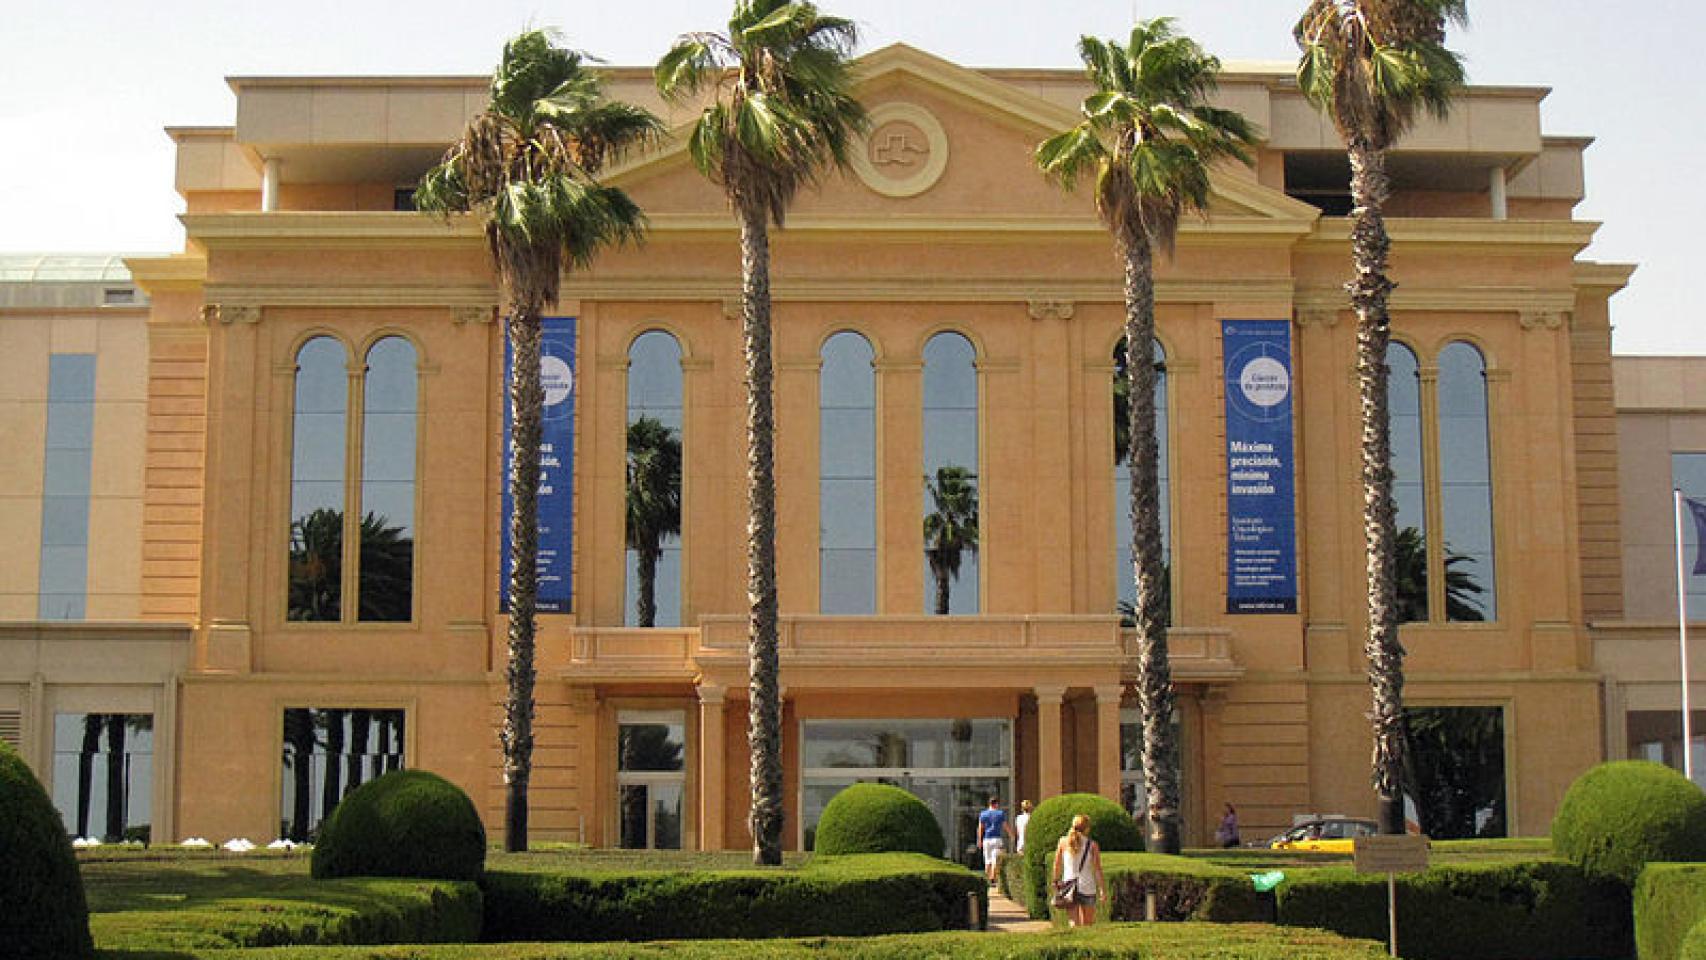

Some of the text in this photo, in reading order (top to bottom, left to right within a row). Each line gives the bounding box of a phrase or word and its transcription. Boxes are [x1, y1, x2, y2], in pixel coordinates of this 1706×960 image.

[1231, 441, 1273, 452] Máxima
[1230, 453, 1281, 469] precisión,
[1230, 469, 1270, 480] mínima
[1232, 481, 1275, 494] invasión
